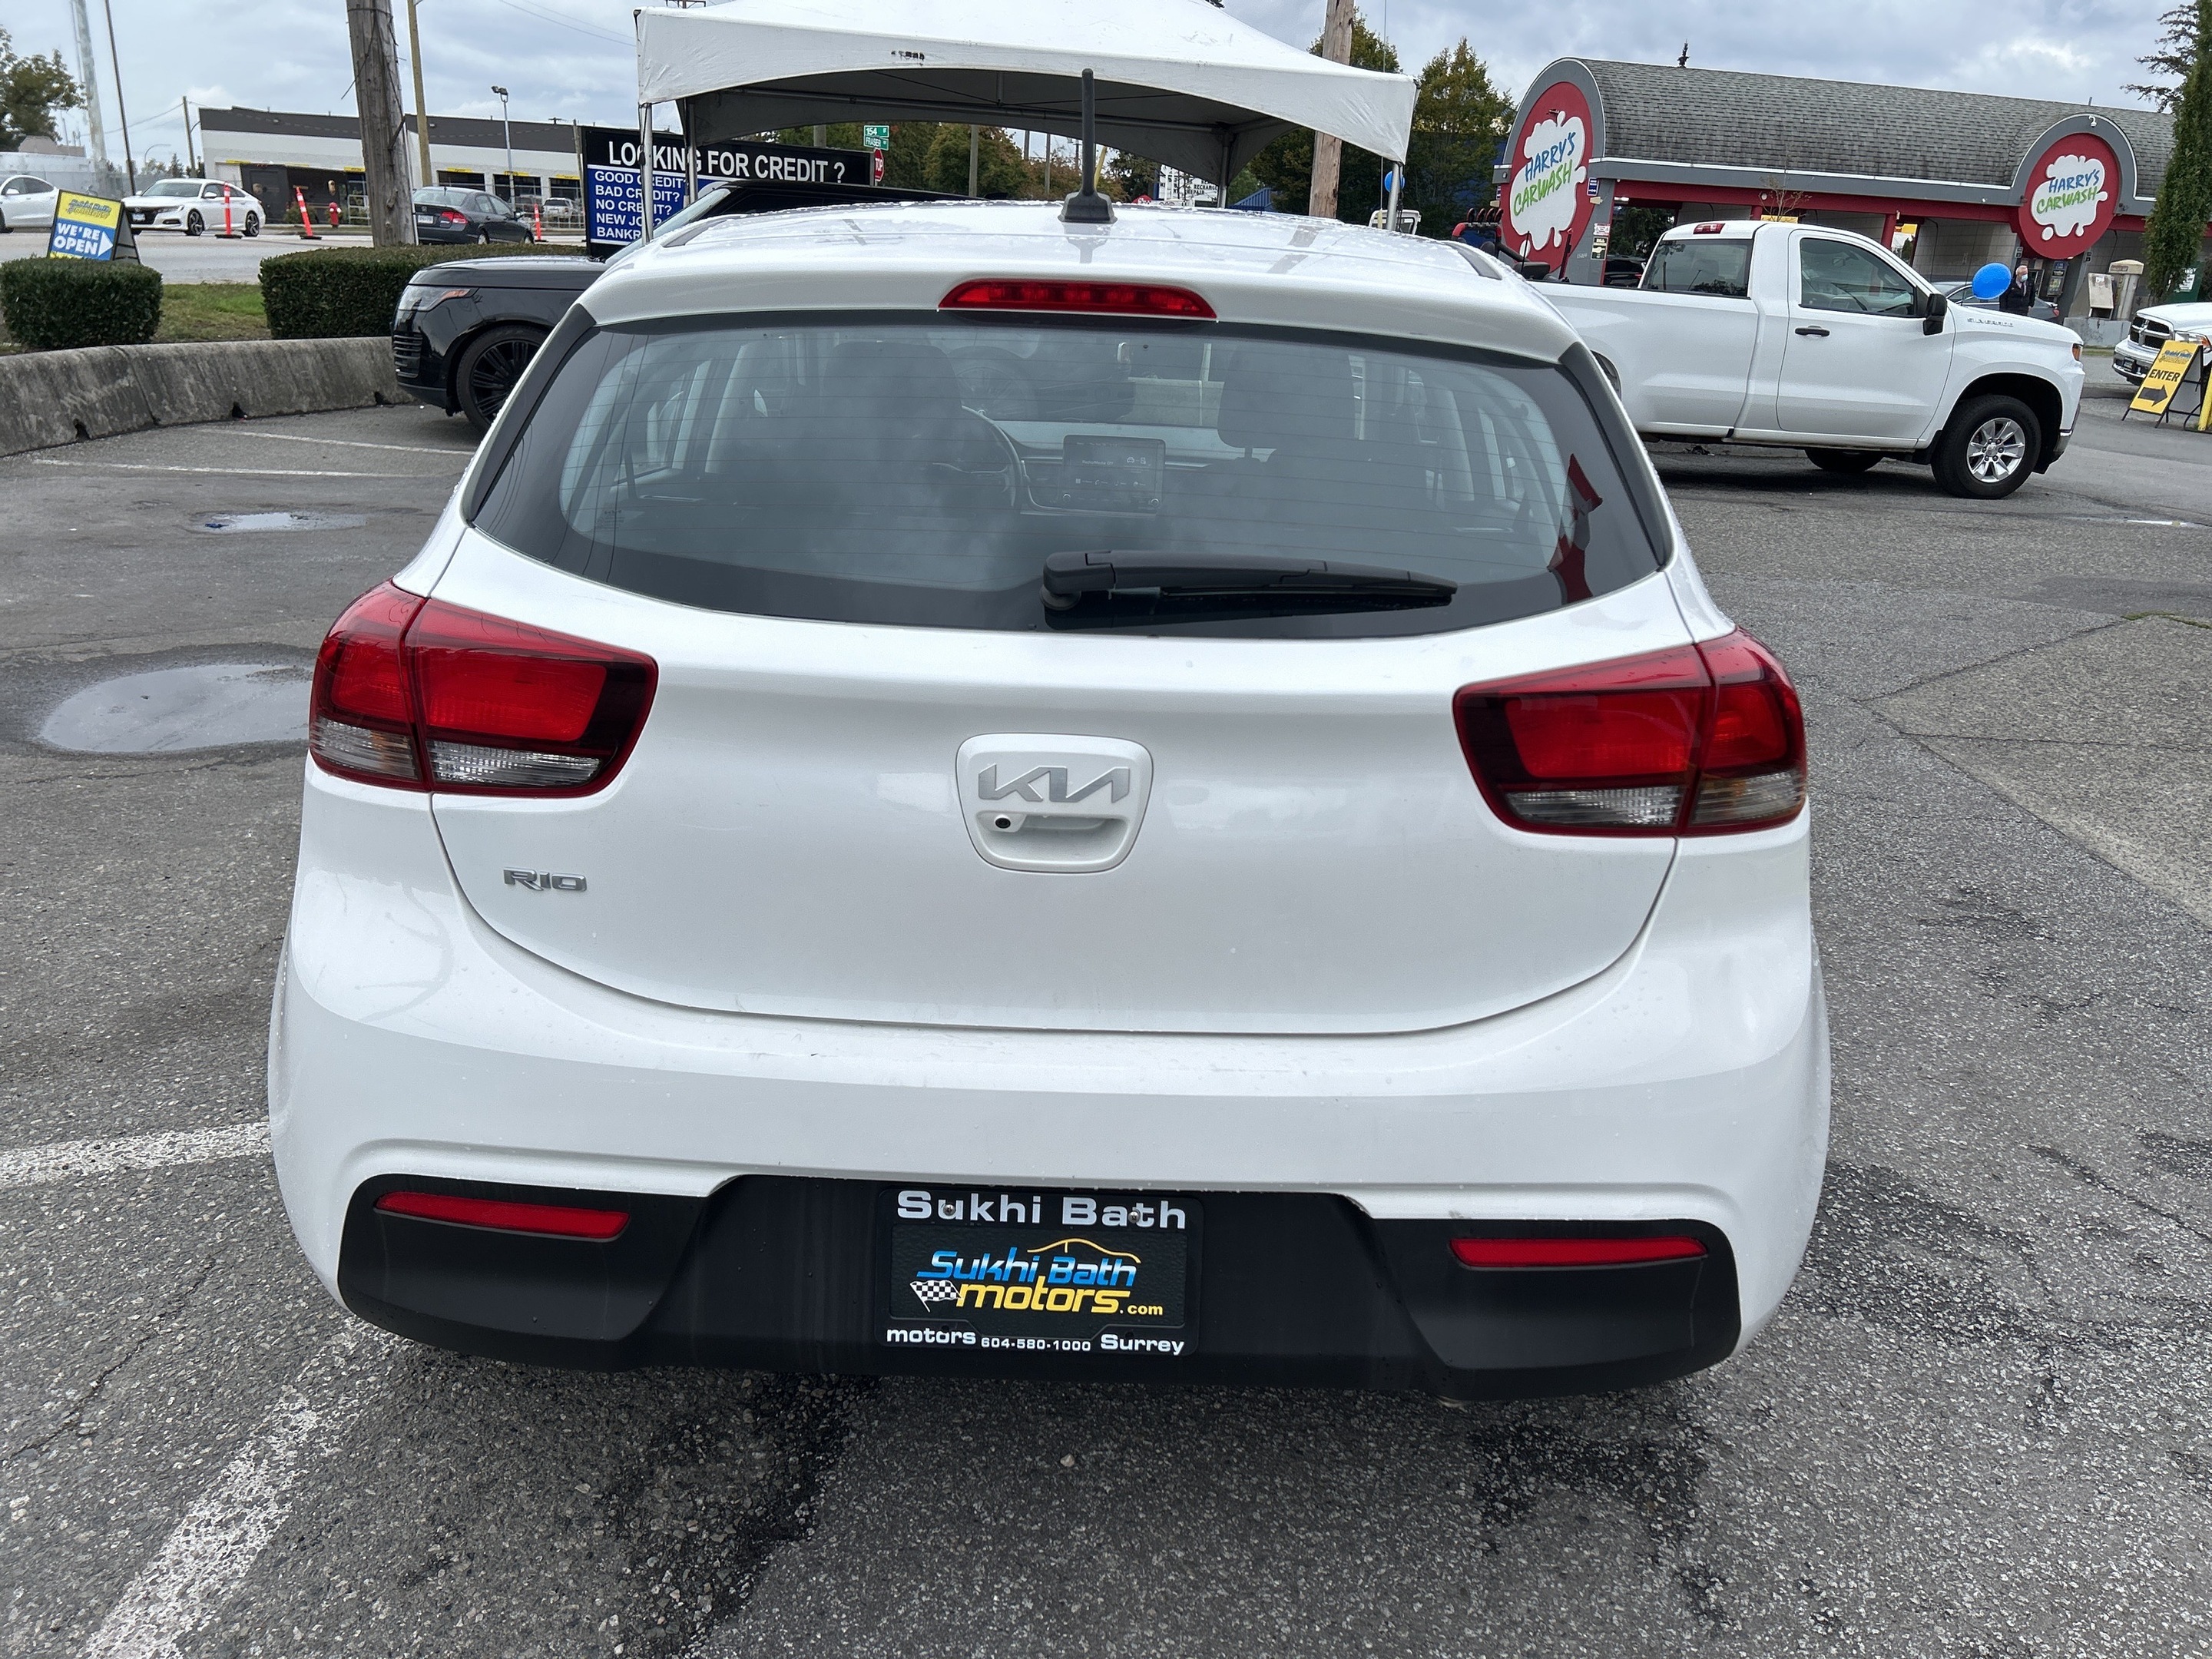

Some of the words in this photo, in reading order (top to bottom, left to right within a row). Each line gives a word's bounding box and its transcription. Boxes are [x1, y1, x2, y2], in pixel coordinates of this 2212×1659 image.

[866, 127, 878, 136] 154
[608, 141, 702, 173] LOKING
[707, 150, 750, 177] FOR
[754, 154, 829, 183] CREDIT
[833, 161, 846, 184] ?
[1525, 131, 1576, 183] HARRY'S
[594, 171, 634, 184] GOOD
[637, 174, 690, 189] EDIT
[1513, 158, 1573, 216] CARWASH
[2048, 168, 2101, 194] HARRY'S
[595, 184, 623, 197] BAD
[626, 187, 680, 203] CRDIT?
[2036, 186, 2098, 214] CARWASH
[595, 198, 615, 210] NO
[618, 201, 672, 216] CREIT?
[596, 213, 626, 225] NEW
[628, 216, 662, 227] JO?
[58, 222, 101, 240] WE'RE
[597, 227, 641, 240] BANKR
[53, 235, 99, 255] OPEN
[2148, 369, 2181, 382] ENTER
[978, 762, 1131, 804] KIA
[503, 866, 588, 892] RIO
[897, 1190, 1041, 1224] Sukhi
[1062, 1196, 1186, 1230] Bath
[916, 1247, 1041, 1283] Sukhi
[1047, 1255, 1137, 1287] Bath
[886, 1327, 977, 1345] motors
[1100, 1333, 1185, 1356] Surrey
